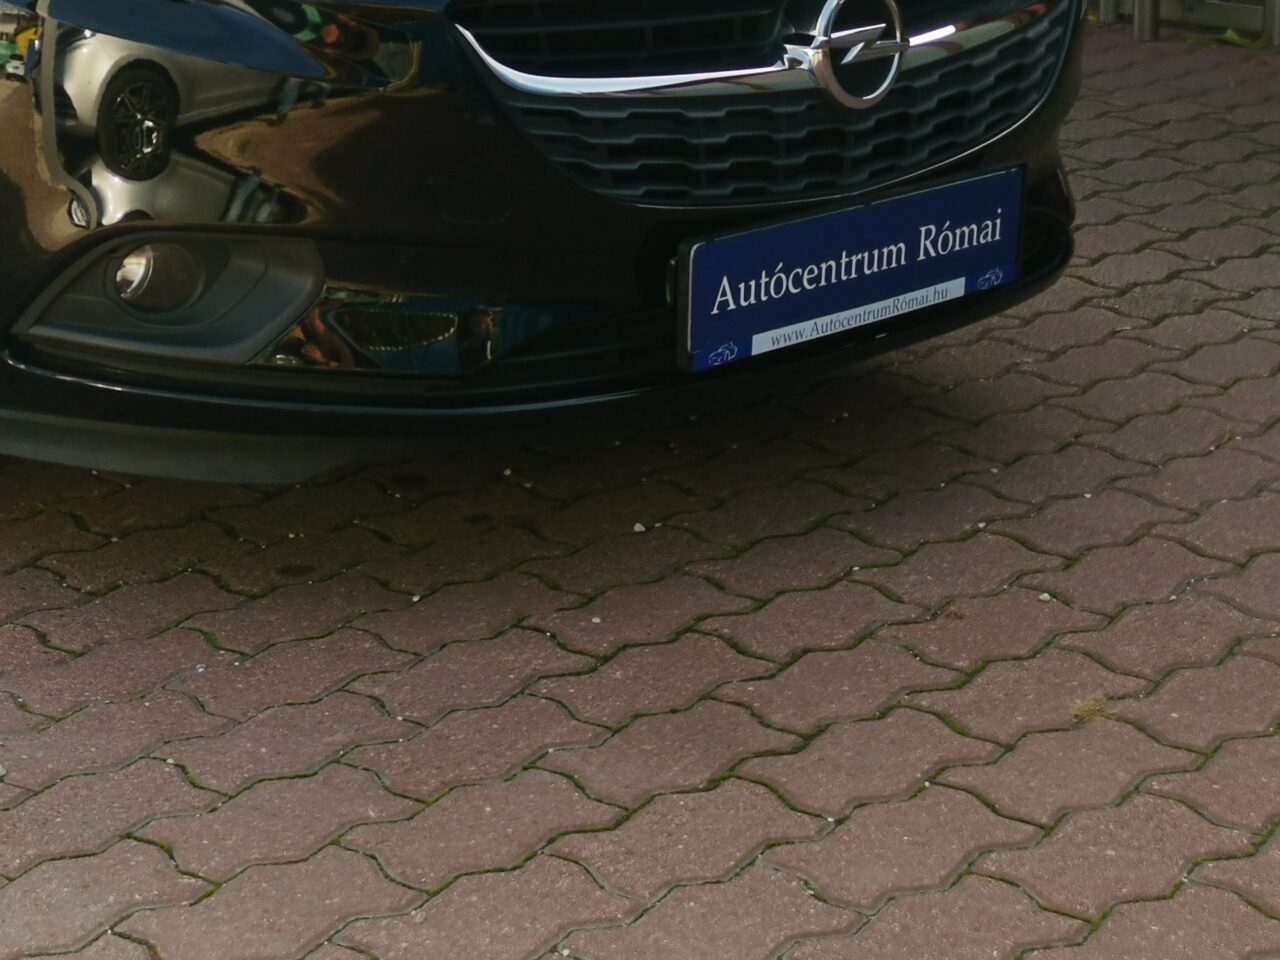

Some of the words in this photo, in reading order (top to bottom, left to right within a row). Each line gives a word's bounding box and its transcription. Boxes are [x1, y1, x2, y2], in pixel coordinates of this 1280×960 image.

[710, 242, 907, 315] Autócentrum
[918, 208, 1002, 261] Római
[771, 286, 948, 349] www.AutócentrumRómai.hu
